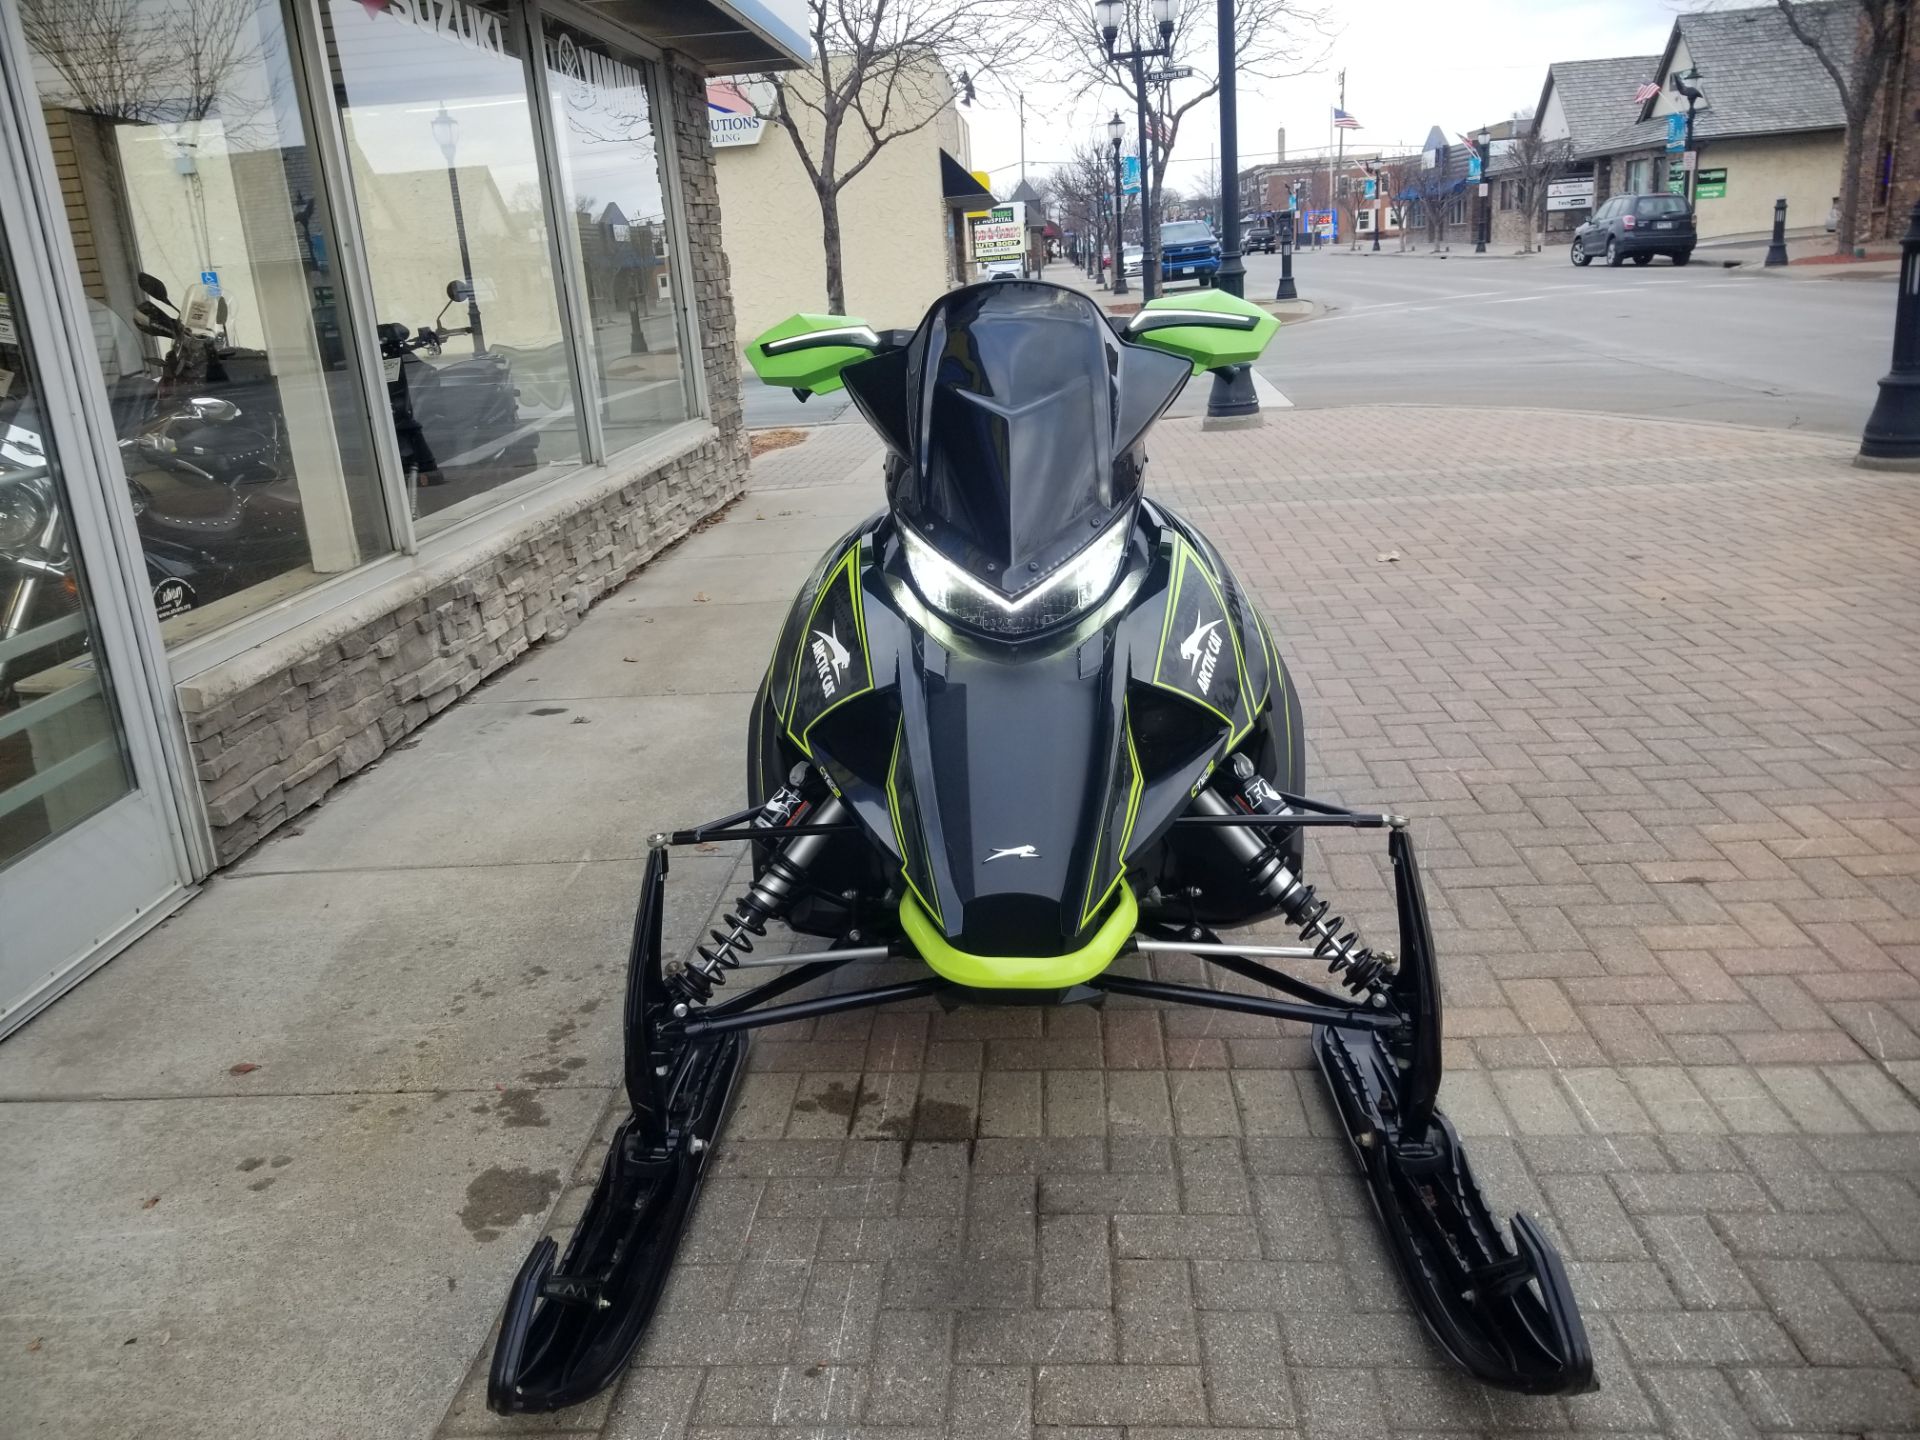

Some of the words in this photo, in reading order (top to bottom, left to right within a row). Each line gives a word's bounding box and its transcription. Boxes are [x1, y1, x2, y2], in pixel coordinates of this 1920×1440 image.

[812, 639, 830, 679] ARCTIC
[822, 674, 835, 698] CAT
[1197, 648, 1217, 696] ARCTIC
[1208, 628, 1222, 655] CAT
